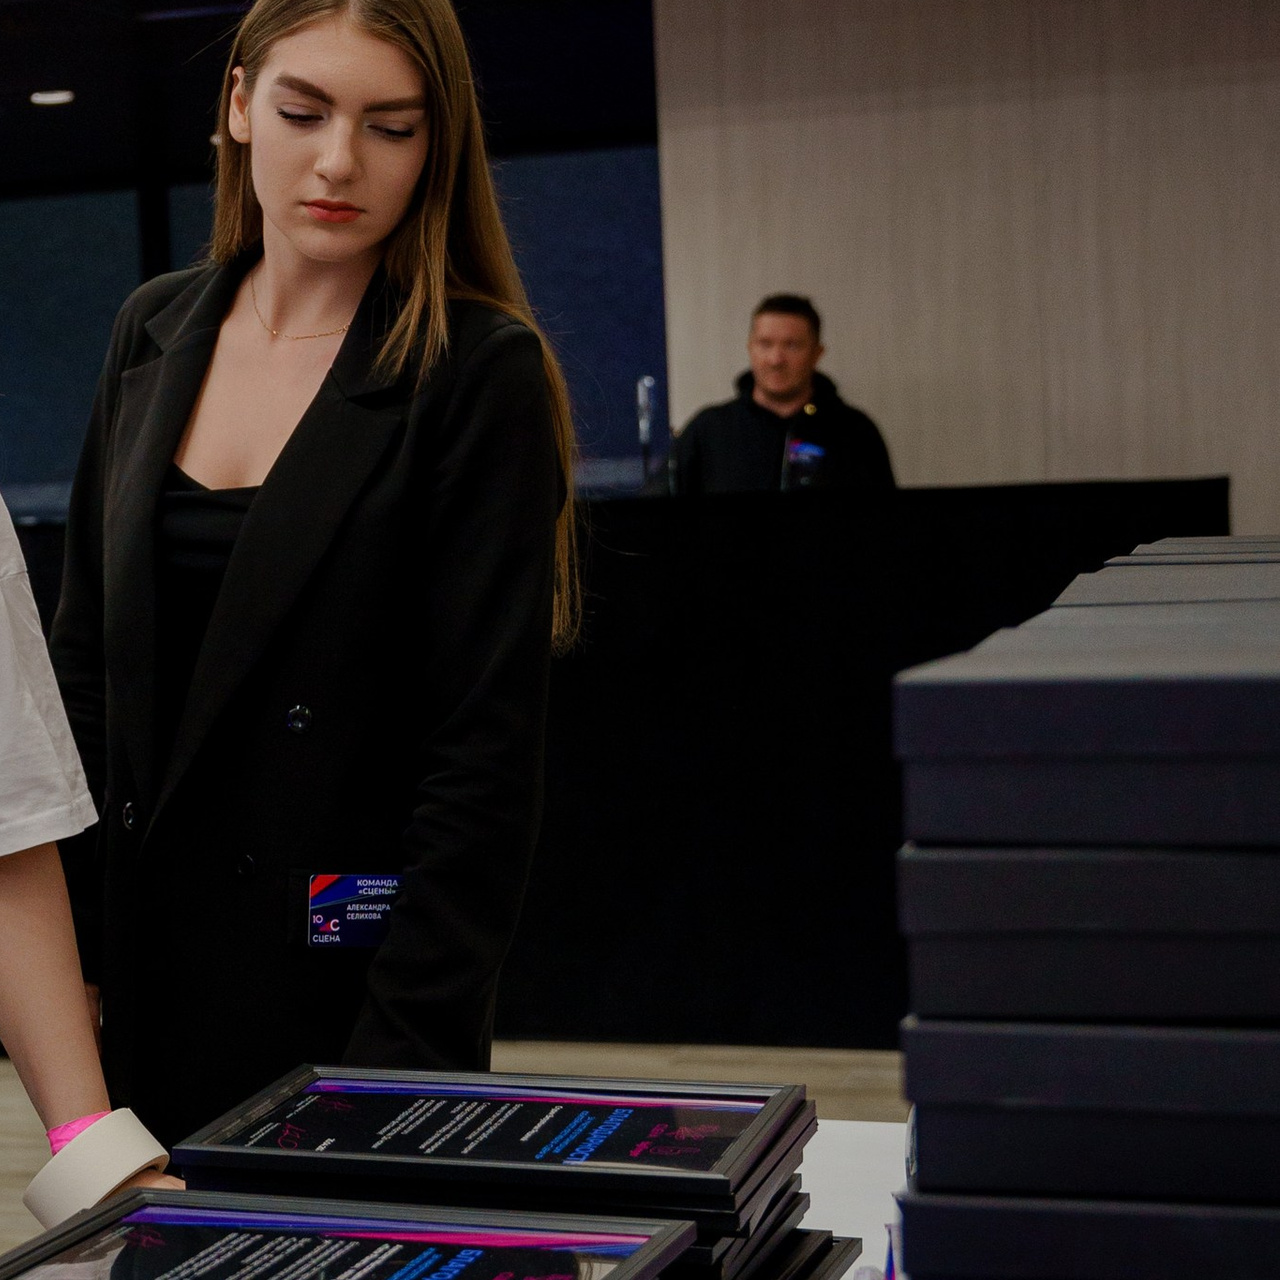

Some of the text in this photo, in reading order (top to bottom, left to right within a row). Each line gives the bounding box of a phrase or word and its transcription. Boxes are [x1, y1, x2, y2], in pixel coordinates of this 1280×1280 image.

[357, 879, 399, 888] КОМАНДА
[346, 904, 391, 912] АЛЕКСАНДРА
[312, 934, 341, 943] СЦЕНА
